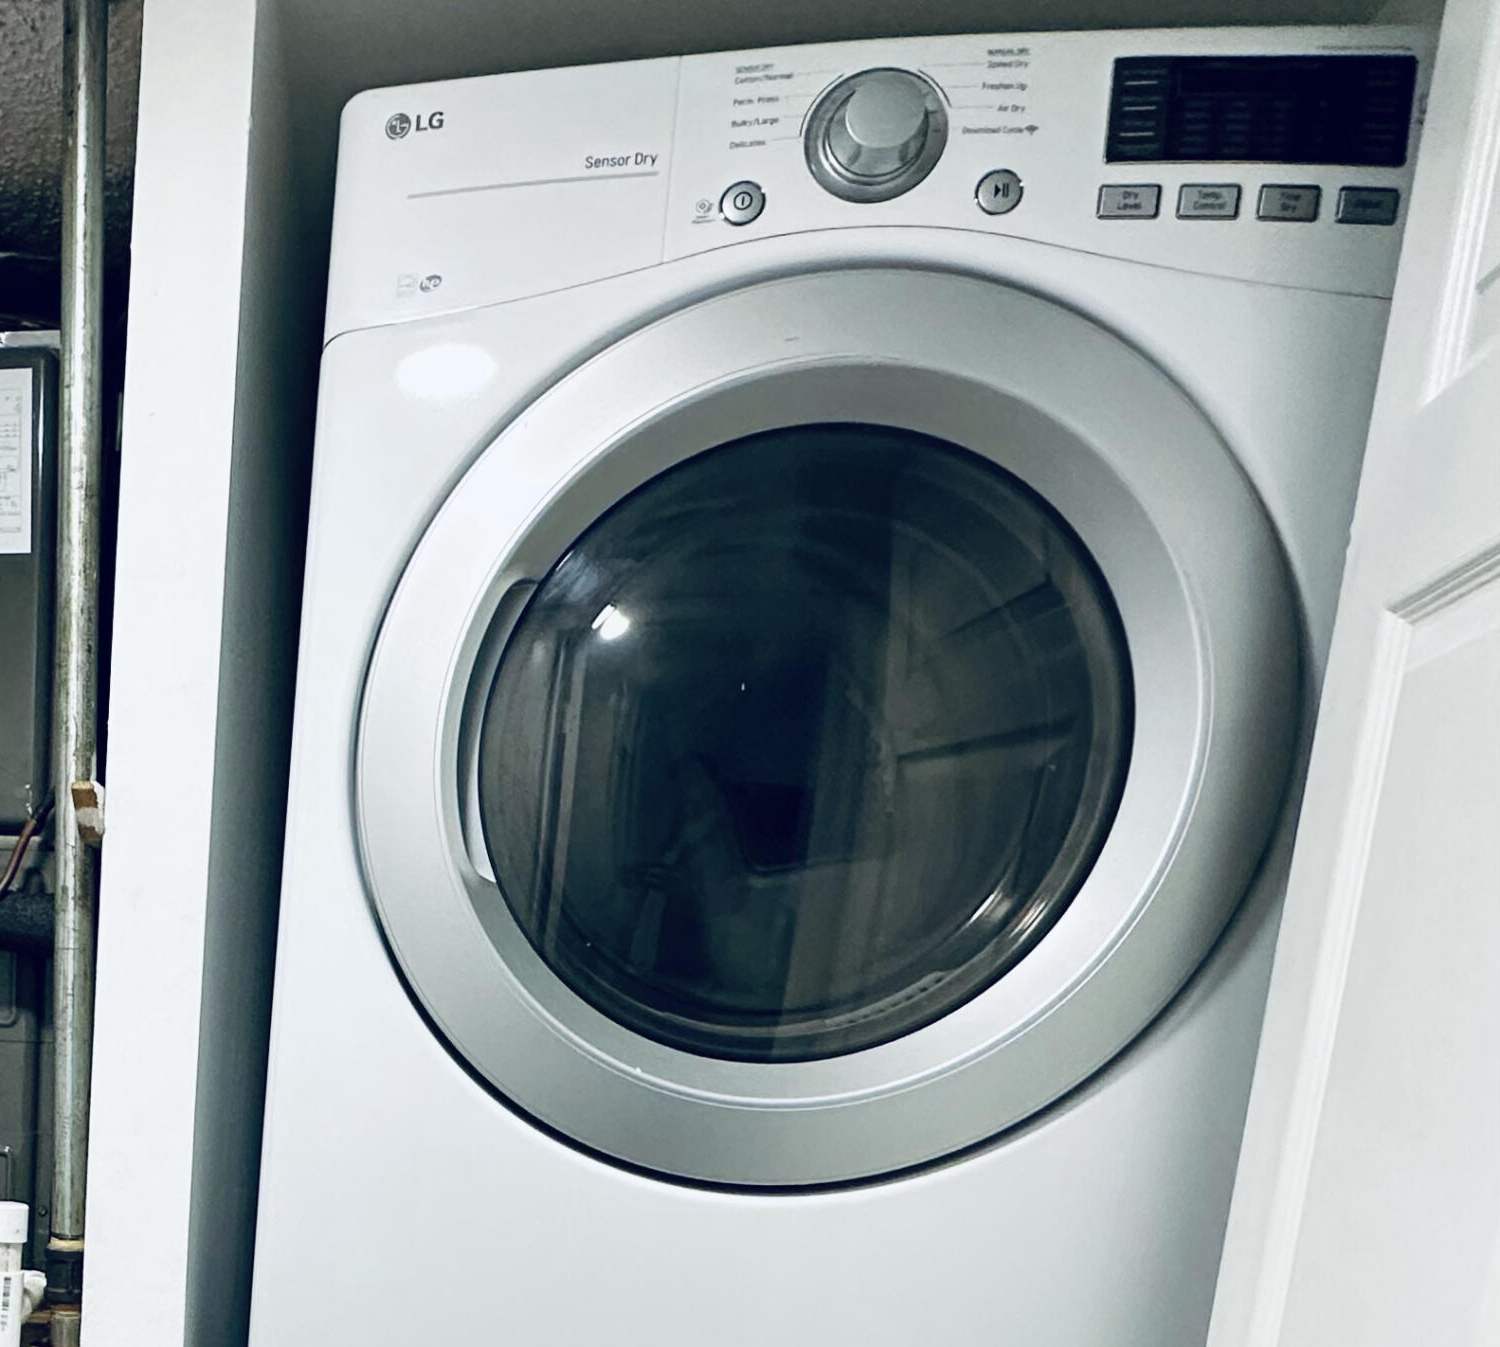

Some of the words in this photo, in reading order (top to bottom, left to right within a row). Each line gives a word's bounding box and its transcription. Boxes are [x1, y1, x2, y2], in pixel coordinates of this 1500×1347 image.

[415, 111, 444, 131] LG
[584, 155, 631, 169] Sensor
[634, 152, 659, 166] Dry
